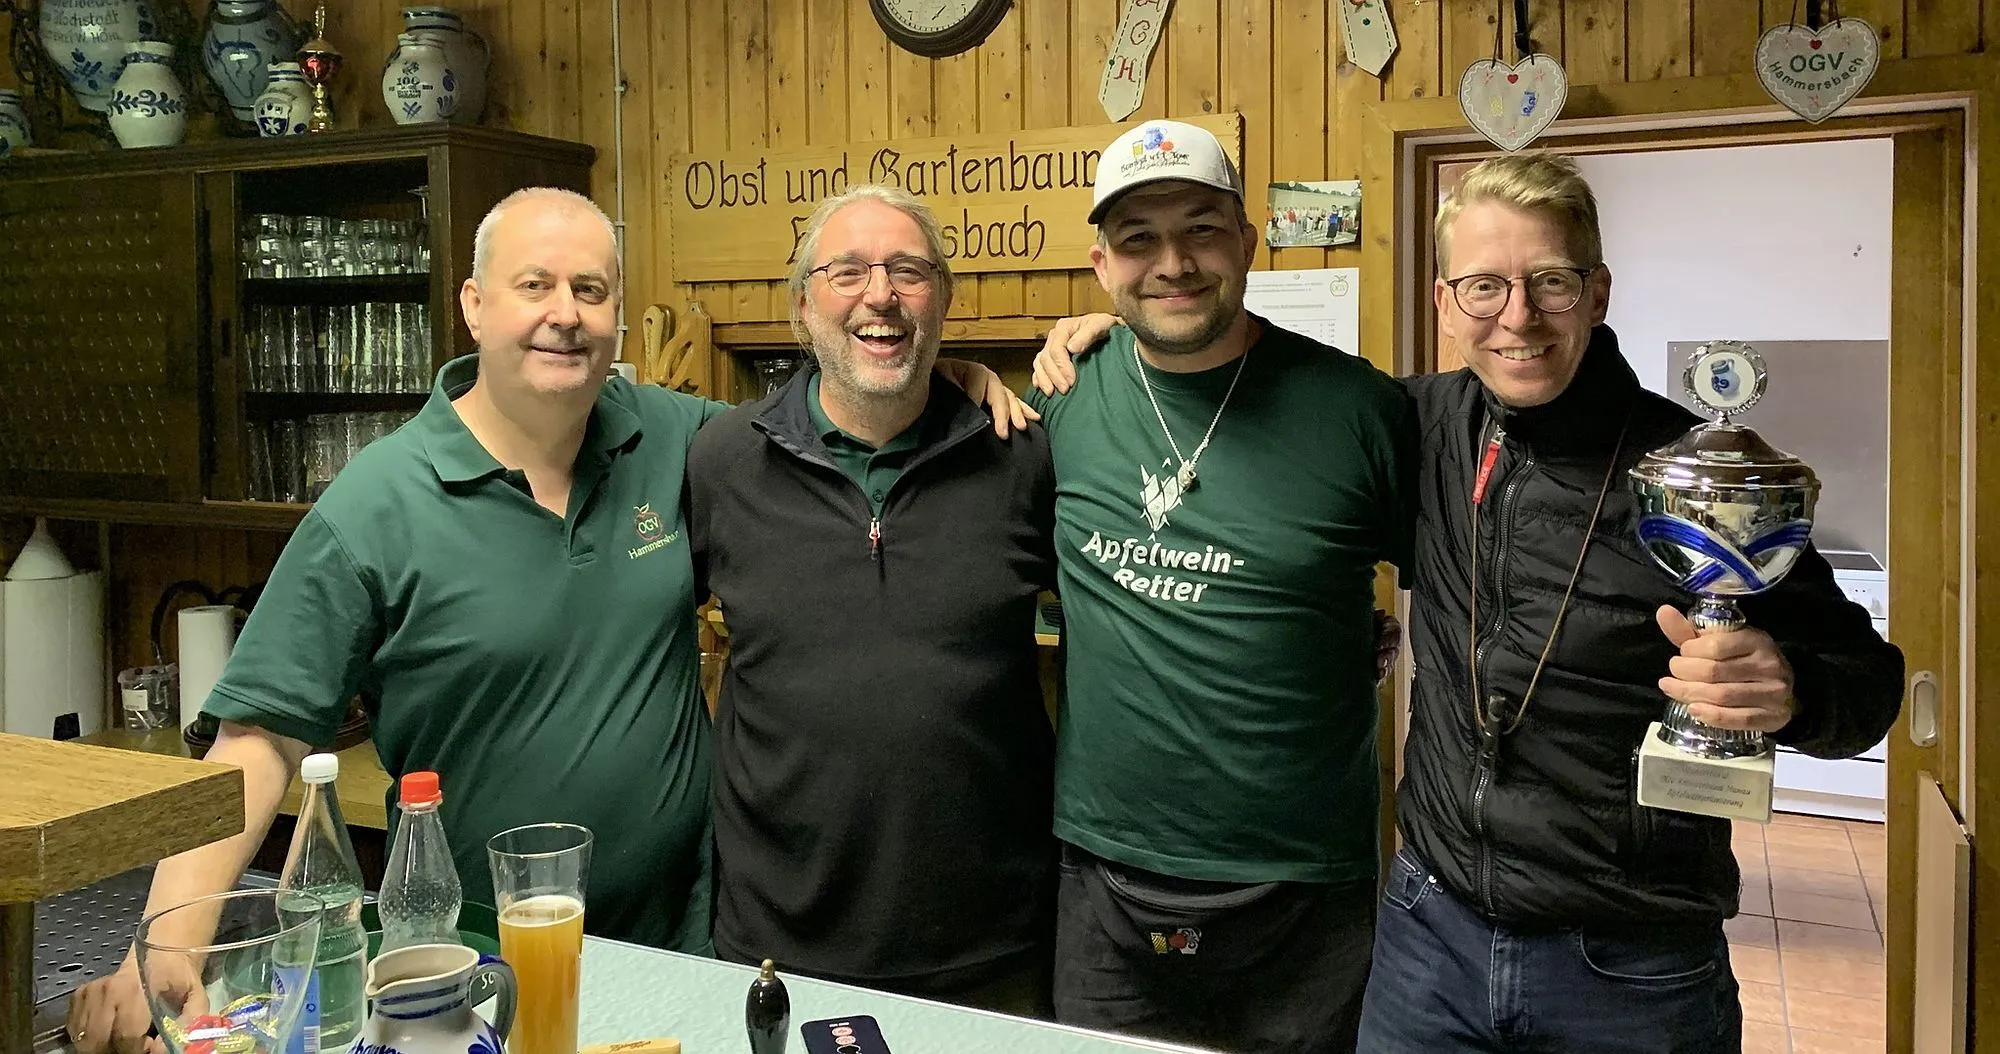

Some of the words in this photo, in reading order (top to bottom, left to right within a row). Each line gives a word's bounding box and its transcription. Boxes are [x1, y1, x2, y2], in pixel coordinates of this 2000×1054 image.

[1769, 56, 1863, 91] Hammersbach
[1789, 51, 1845, 73] OGV
[685, 156, 768, 210] Obst
[785, 152, 849, 204] und
[637, 516, 659, 534] OGV
[1081, 531, 1245, 574] Apfelwein-
[1113, 567, 1208, 603] Retter
